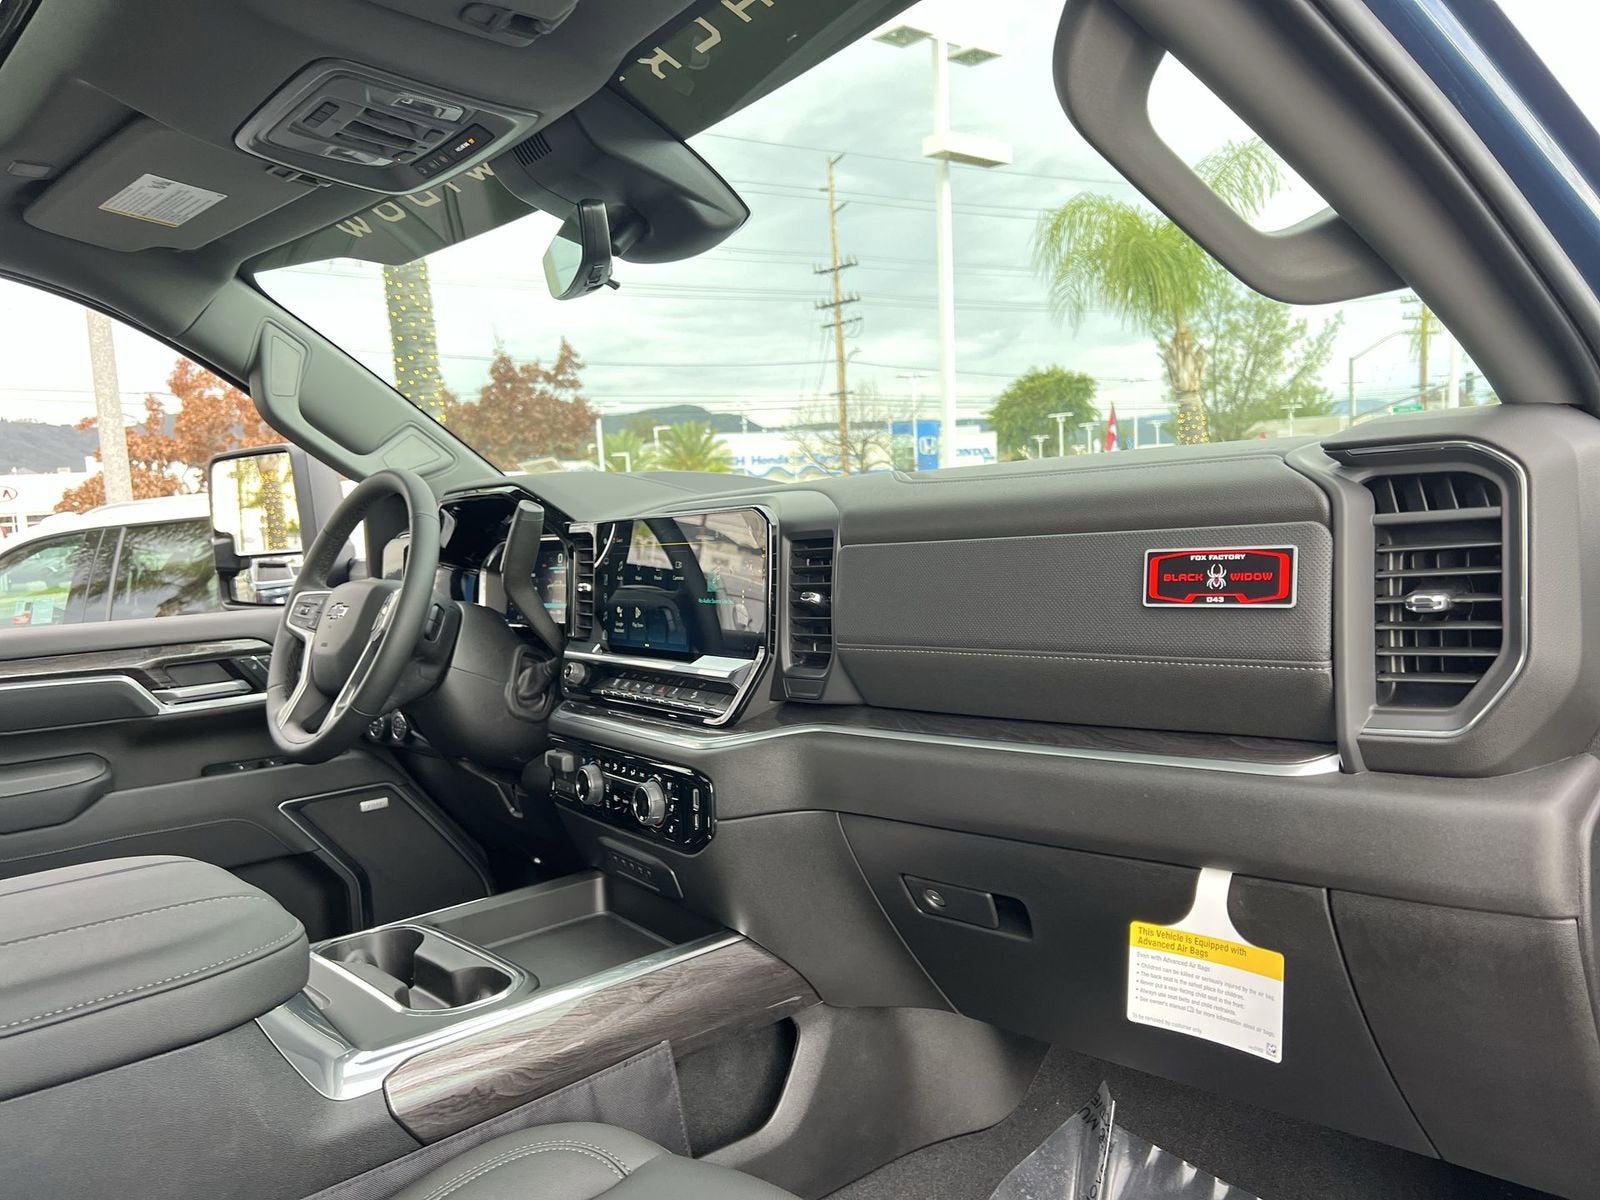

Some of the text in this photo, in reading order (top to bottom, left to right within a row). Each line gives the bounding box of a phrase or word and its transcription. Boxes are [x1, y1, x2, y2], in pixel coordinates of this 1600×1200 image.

[1208, 553, 1246, 561] FACTORY
[1163, 572, 1273, 581] BLACK WIDOW
[1137, 927, 1154, 937] This
[1155, 930, 1183, 942] Vehicle
[1194, 938, 1228, 953] Equipped
[1230, 946, 1246, 956] with
[1137, 937, 1208, 959] Advanced Air Bags
[1162, 956, 1187, 967] Advanced
